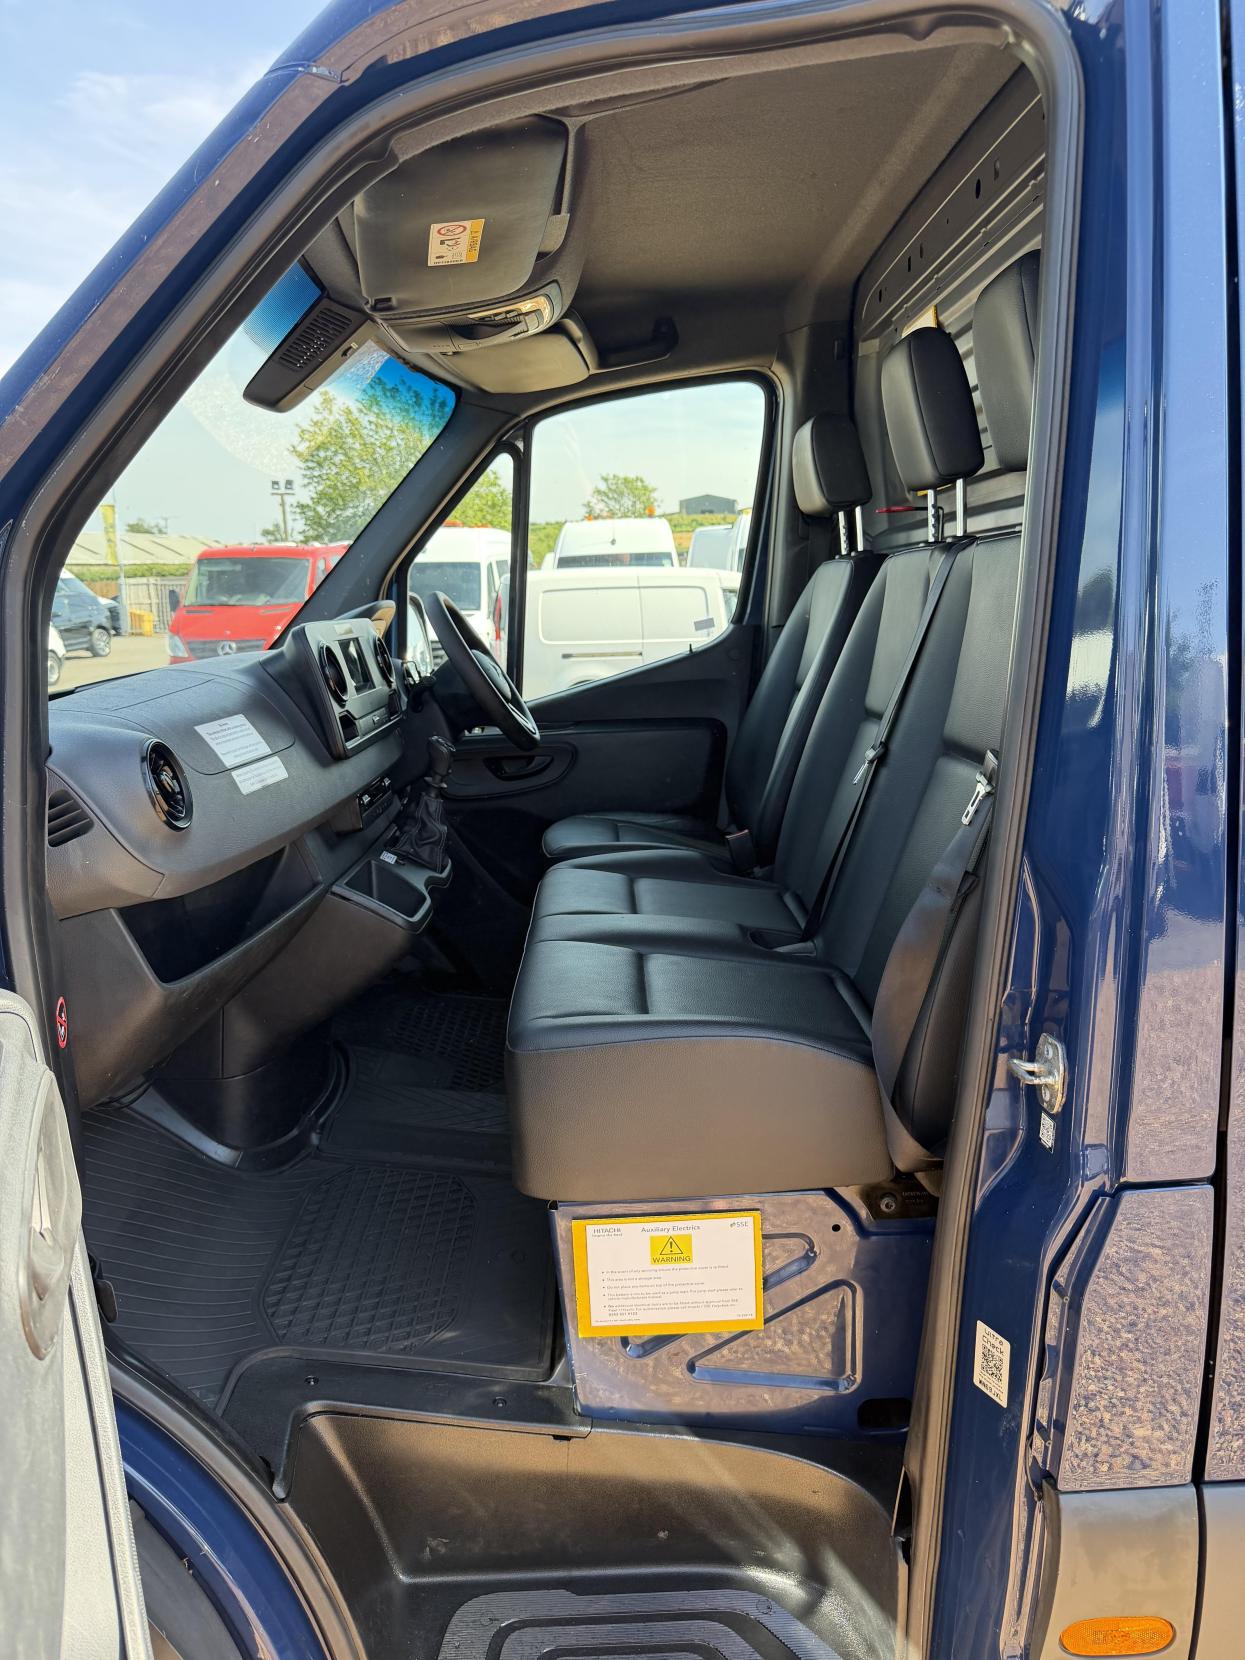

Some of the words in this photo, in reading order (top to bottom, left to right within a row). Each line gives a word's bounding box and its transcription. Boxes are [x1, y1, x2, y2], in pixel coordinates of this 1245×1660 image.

[641, 1225, 670, 1233] Auxiliary
[672, 1224, 701, 1232] Electrics
[652, 1255, 691, 1264] WARNING
